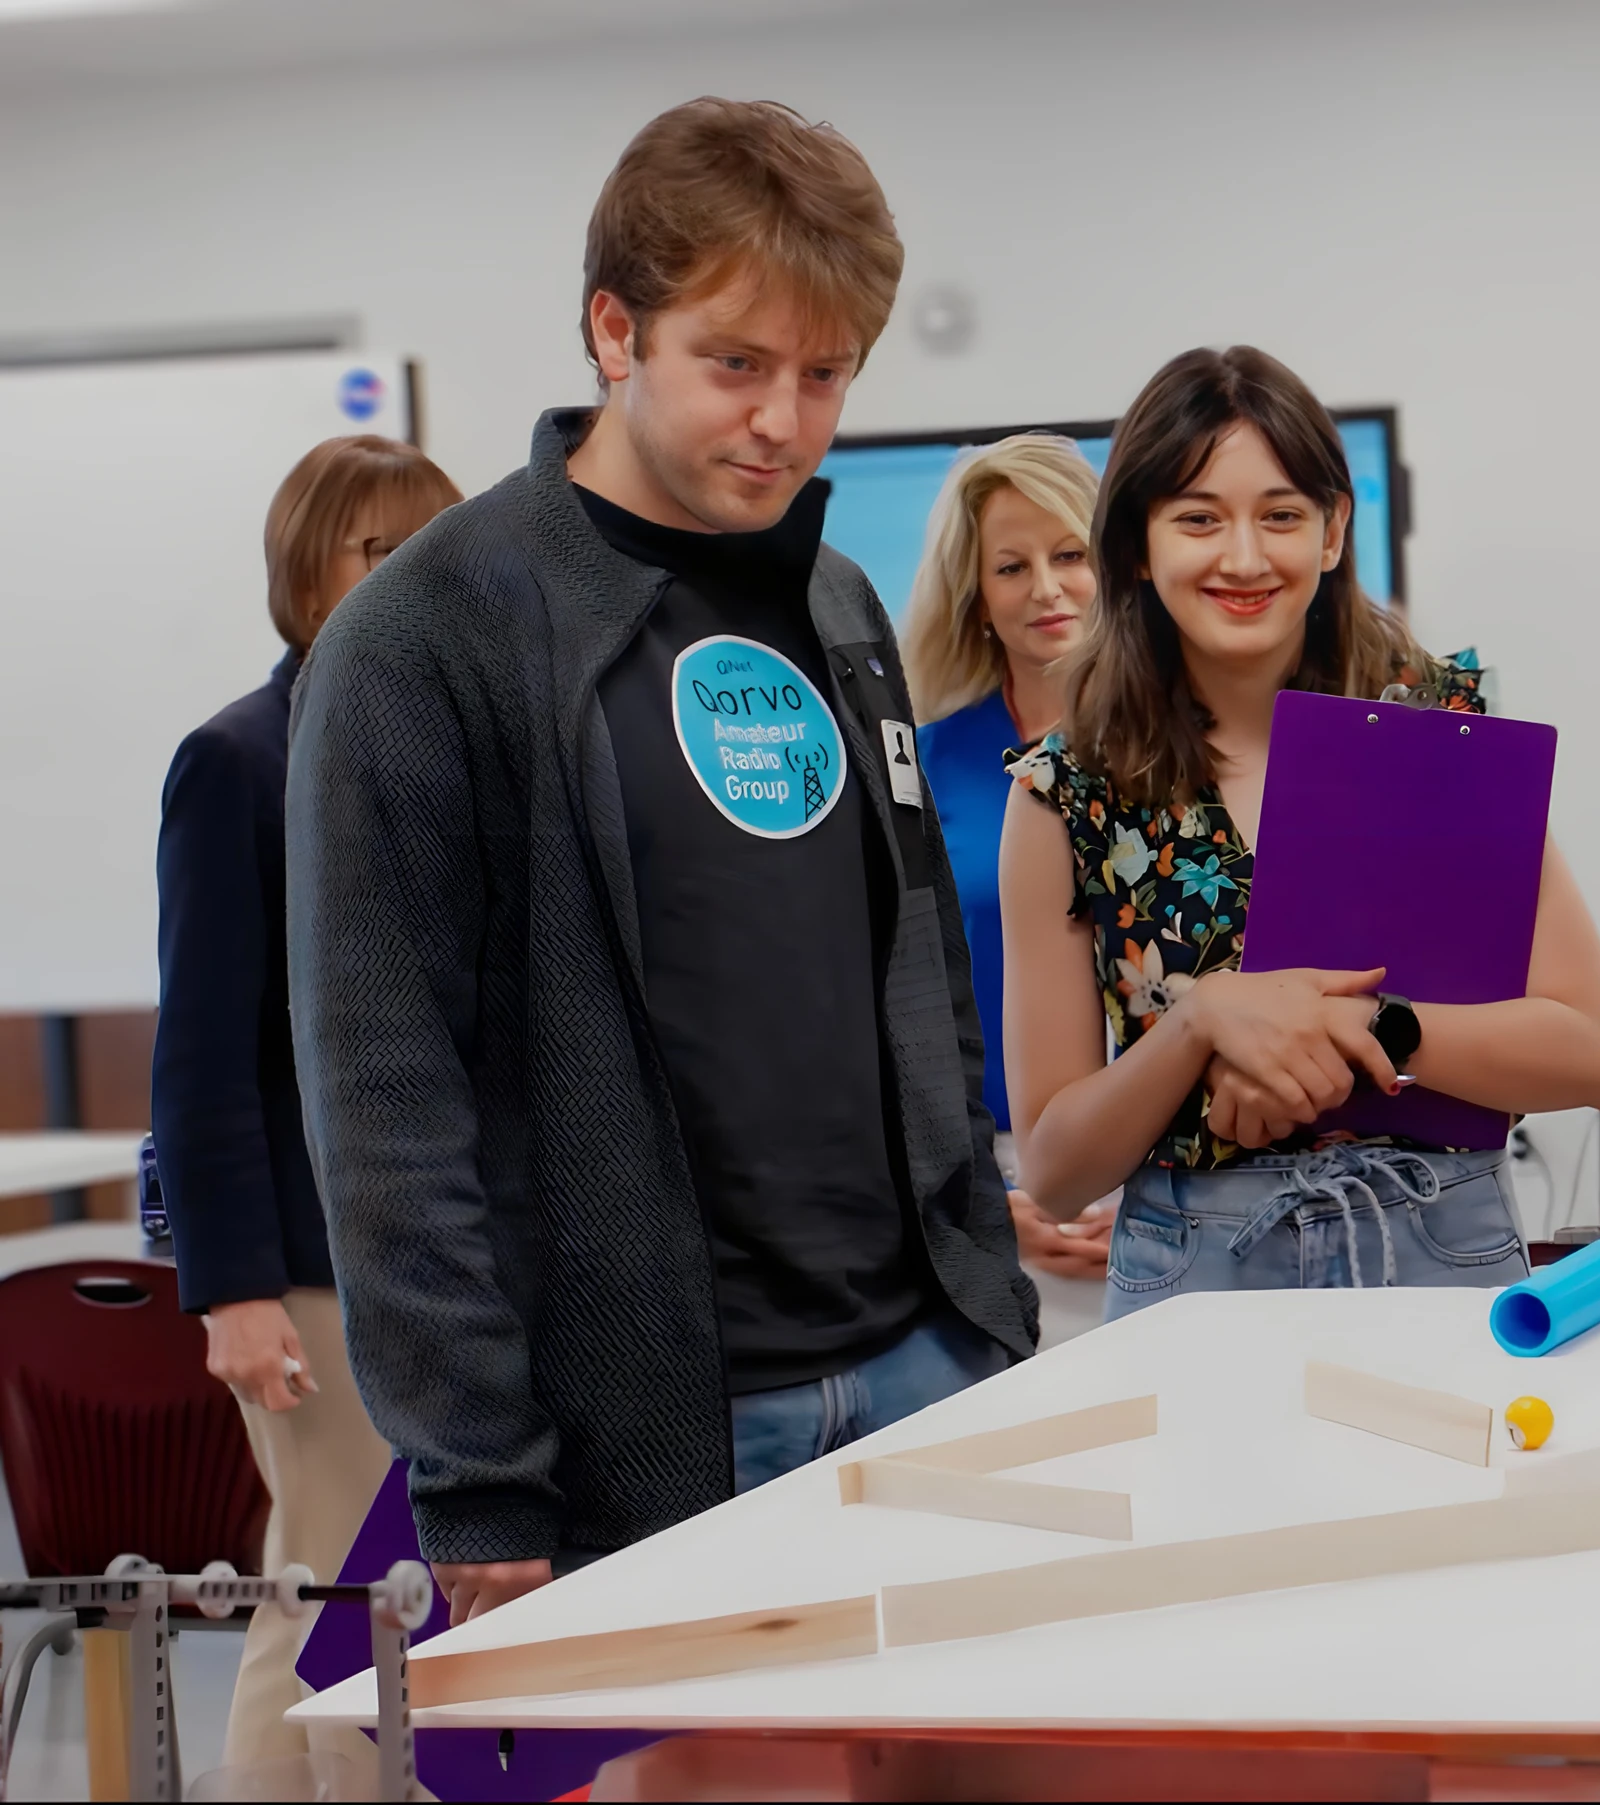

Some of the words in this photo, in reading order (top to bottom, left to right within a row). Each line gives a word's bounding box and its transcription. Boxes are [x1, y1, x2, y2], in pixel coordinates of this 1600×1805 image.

[692, 680, 803, 716] Qorvo
[713, 718, 807, 742] Amateur
[720, 746, 781, 770] Radio
[725, 775, 790, 805] Group
